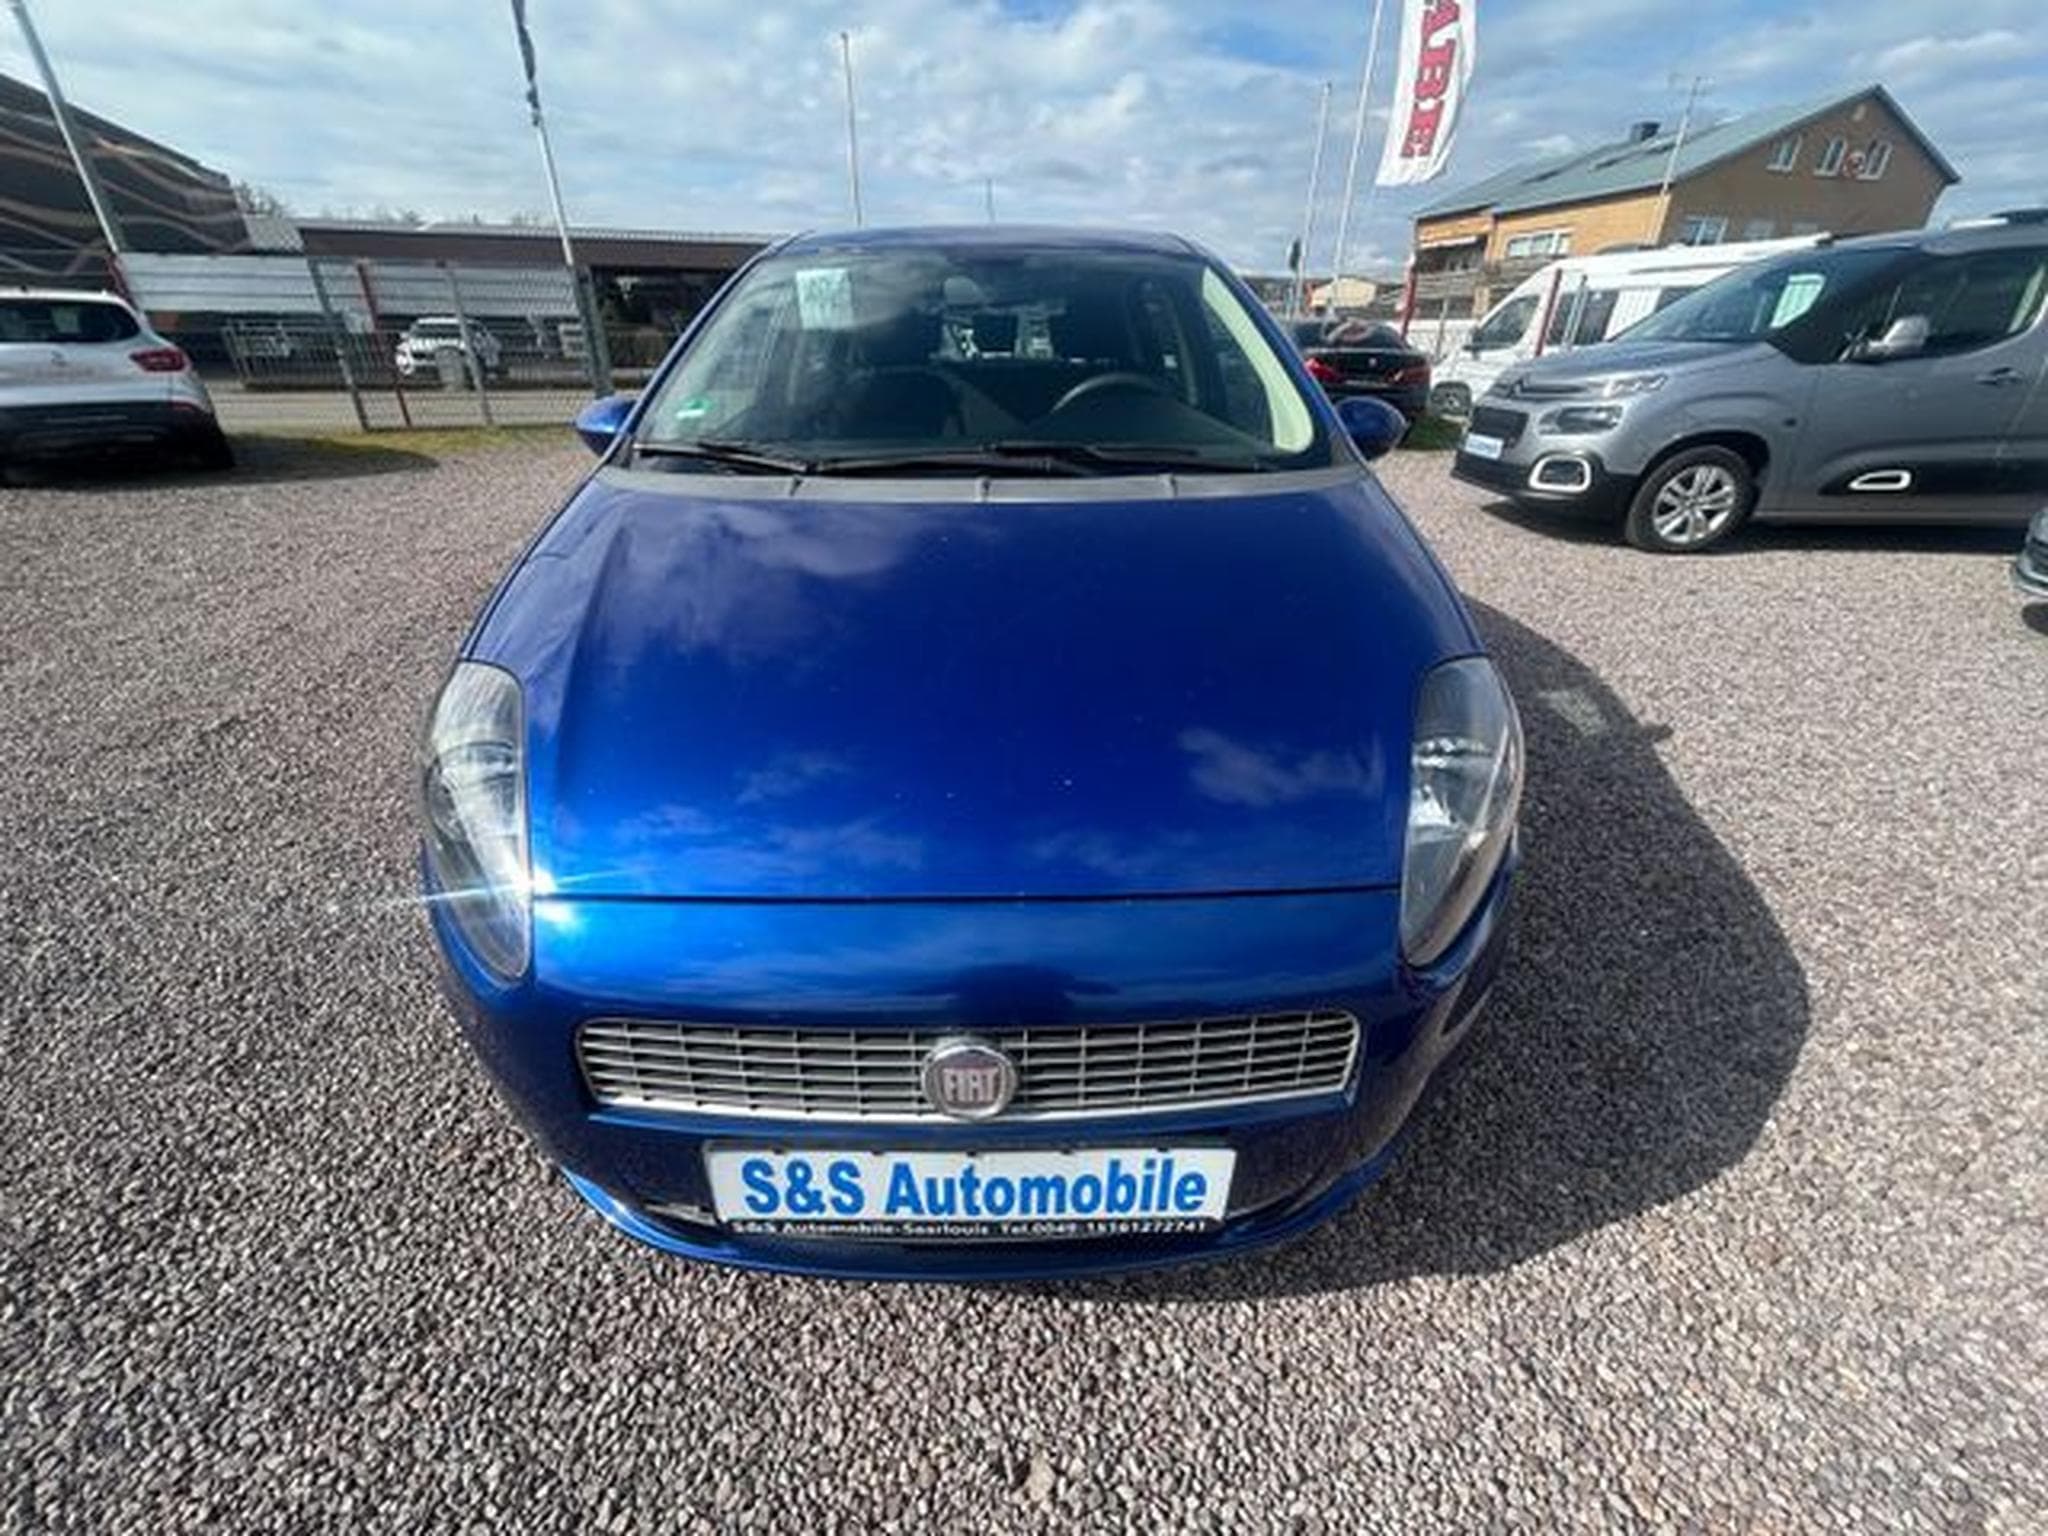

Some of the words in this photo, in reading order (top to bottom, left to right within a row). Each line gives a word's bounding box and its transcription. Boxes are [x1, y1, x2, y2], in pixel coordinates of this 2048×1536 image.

[943, 1066, 999, 1102] FIAT
[740, 1158, 864, 1215] S&S
[885, 1157, 1208, 1217] Automobile
